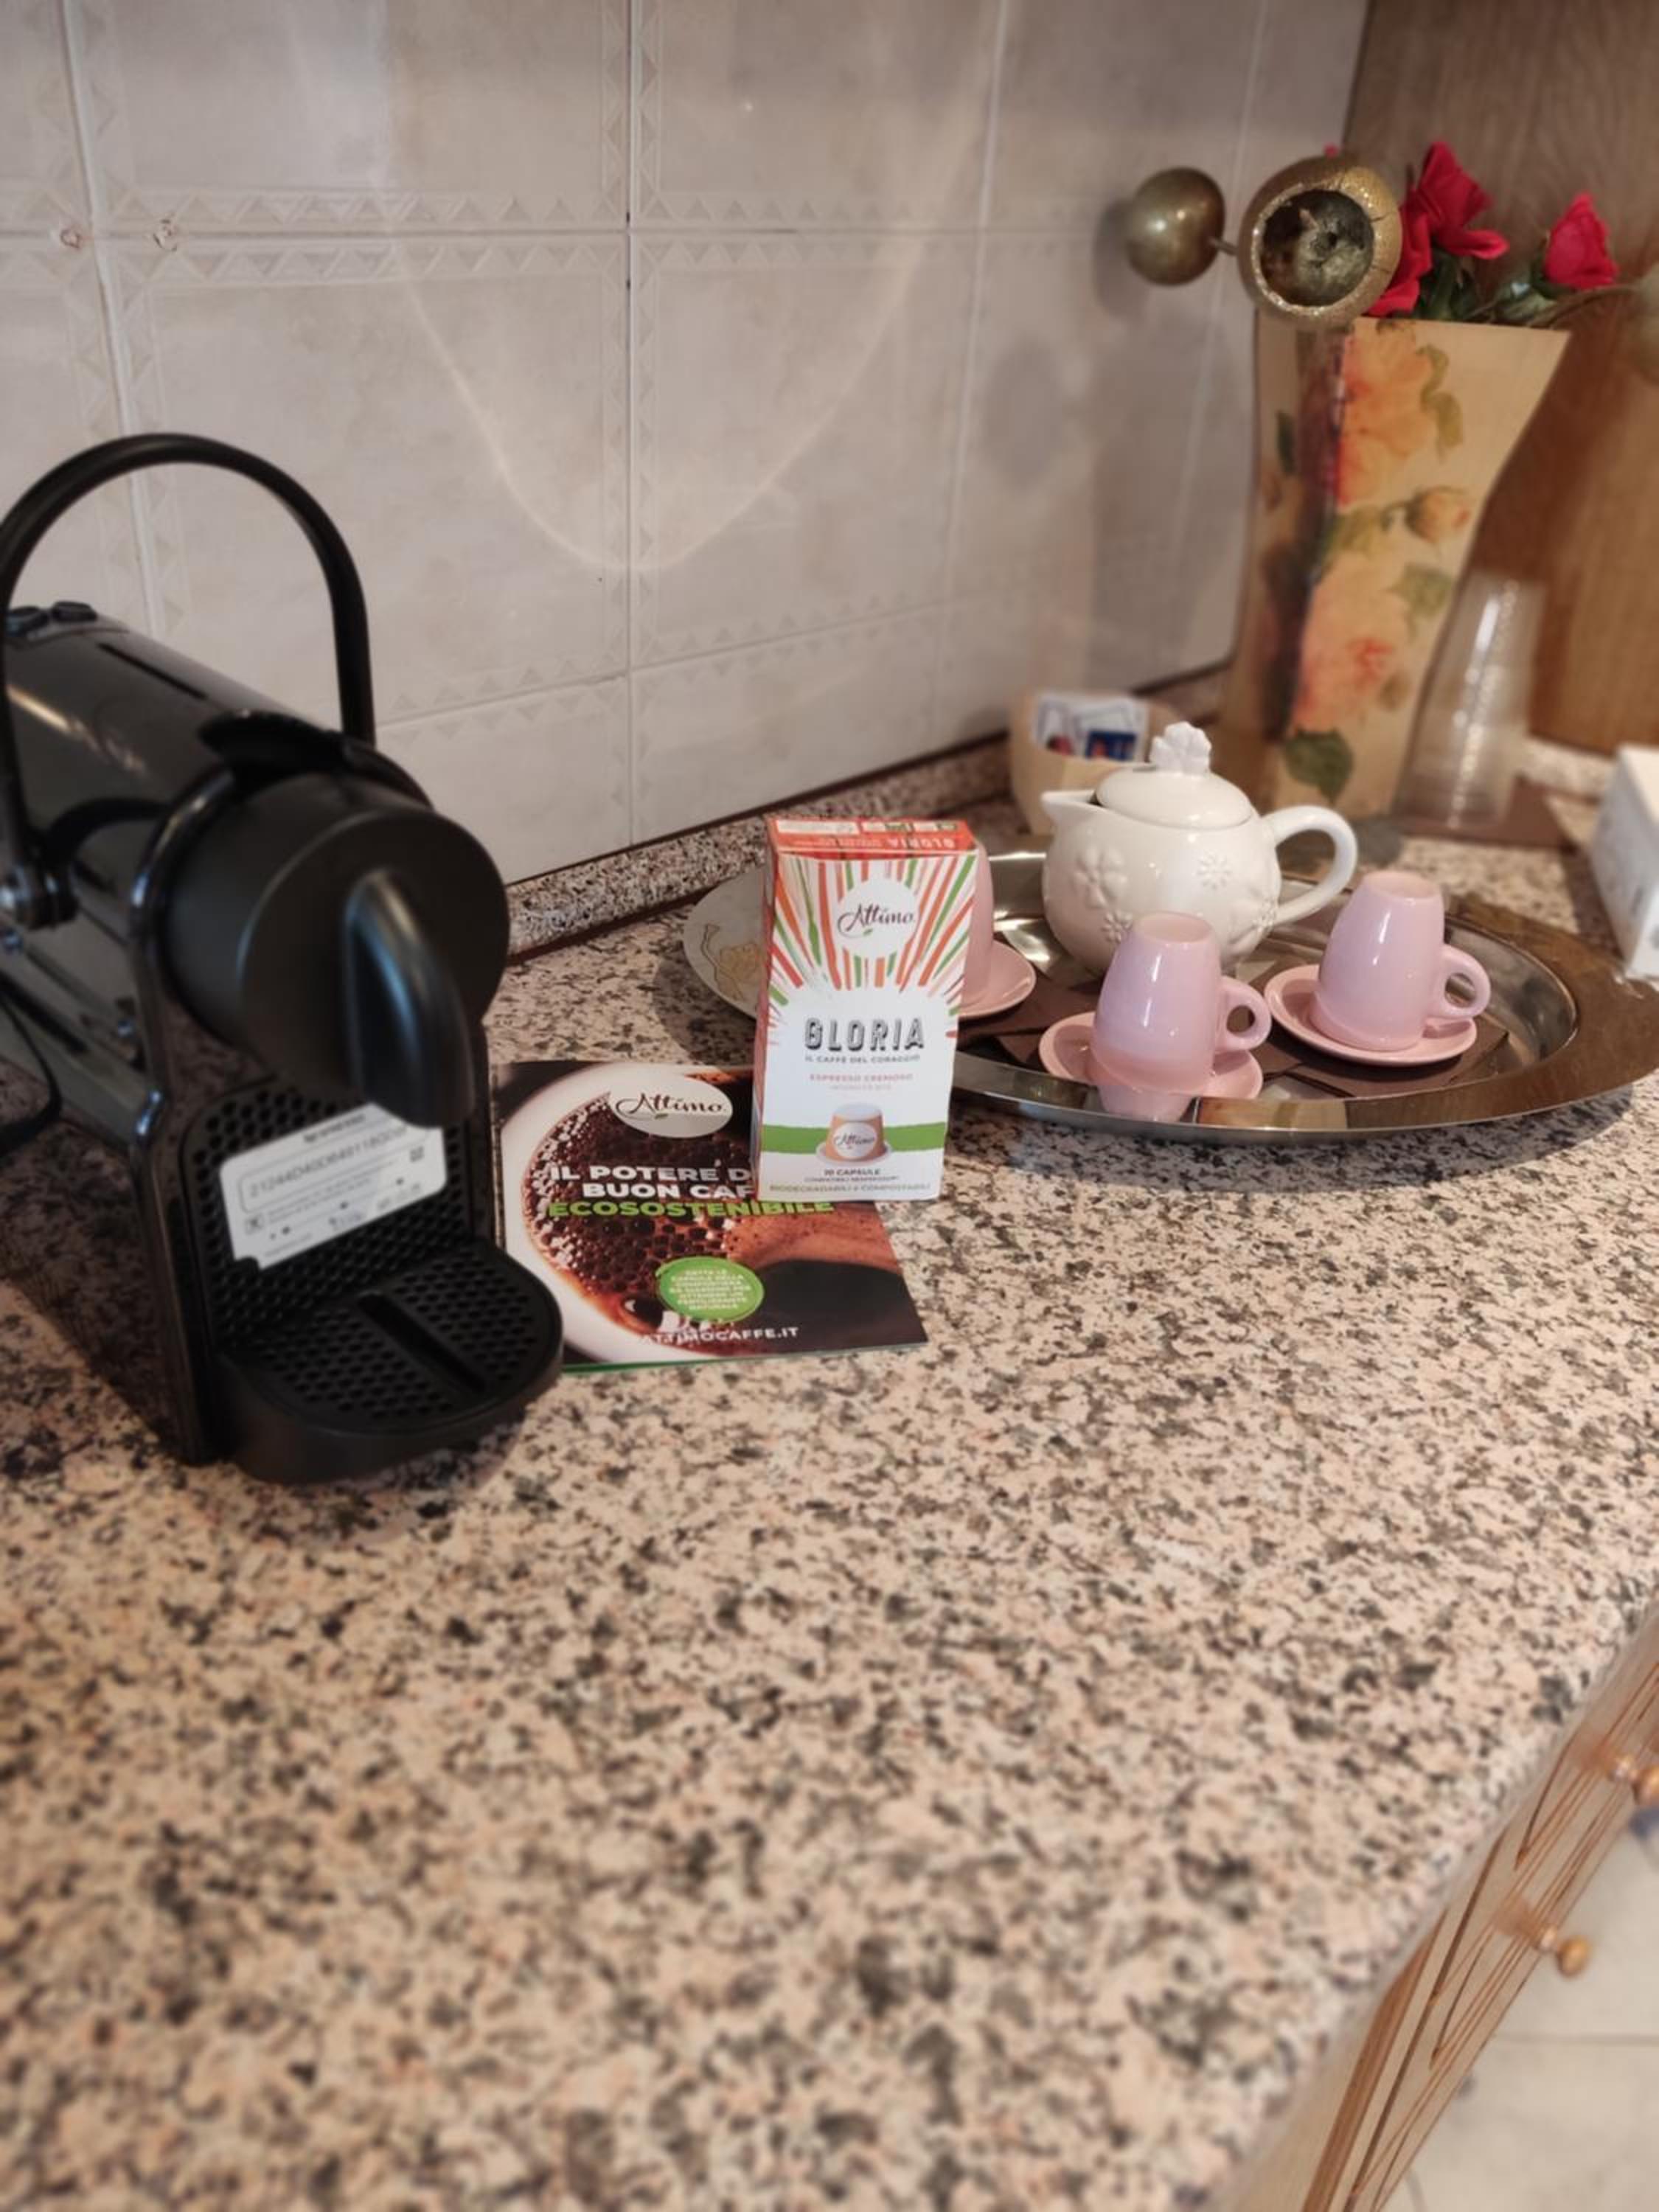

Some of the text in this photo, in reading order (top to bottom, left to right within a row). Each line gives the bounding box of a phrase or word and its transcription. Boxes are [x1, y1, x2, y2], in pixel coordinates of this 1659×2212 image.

[838, 902, 914, 938] Attimo
[804, 1017, 925, 1052] GLORIA
[615, 1092, 723, 1121] Attimo
[549, 1166, 752, 1181] IL POTERE D
[836, 1168, 881, 1176] CAPSULE
[582, 1183, 754, 1200] BUON CAF
[547, 1200, 835, 1218] ECOSOSTENIBILE
